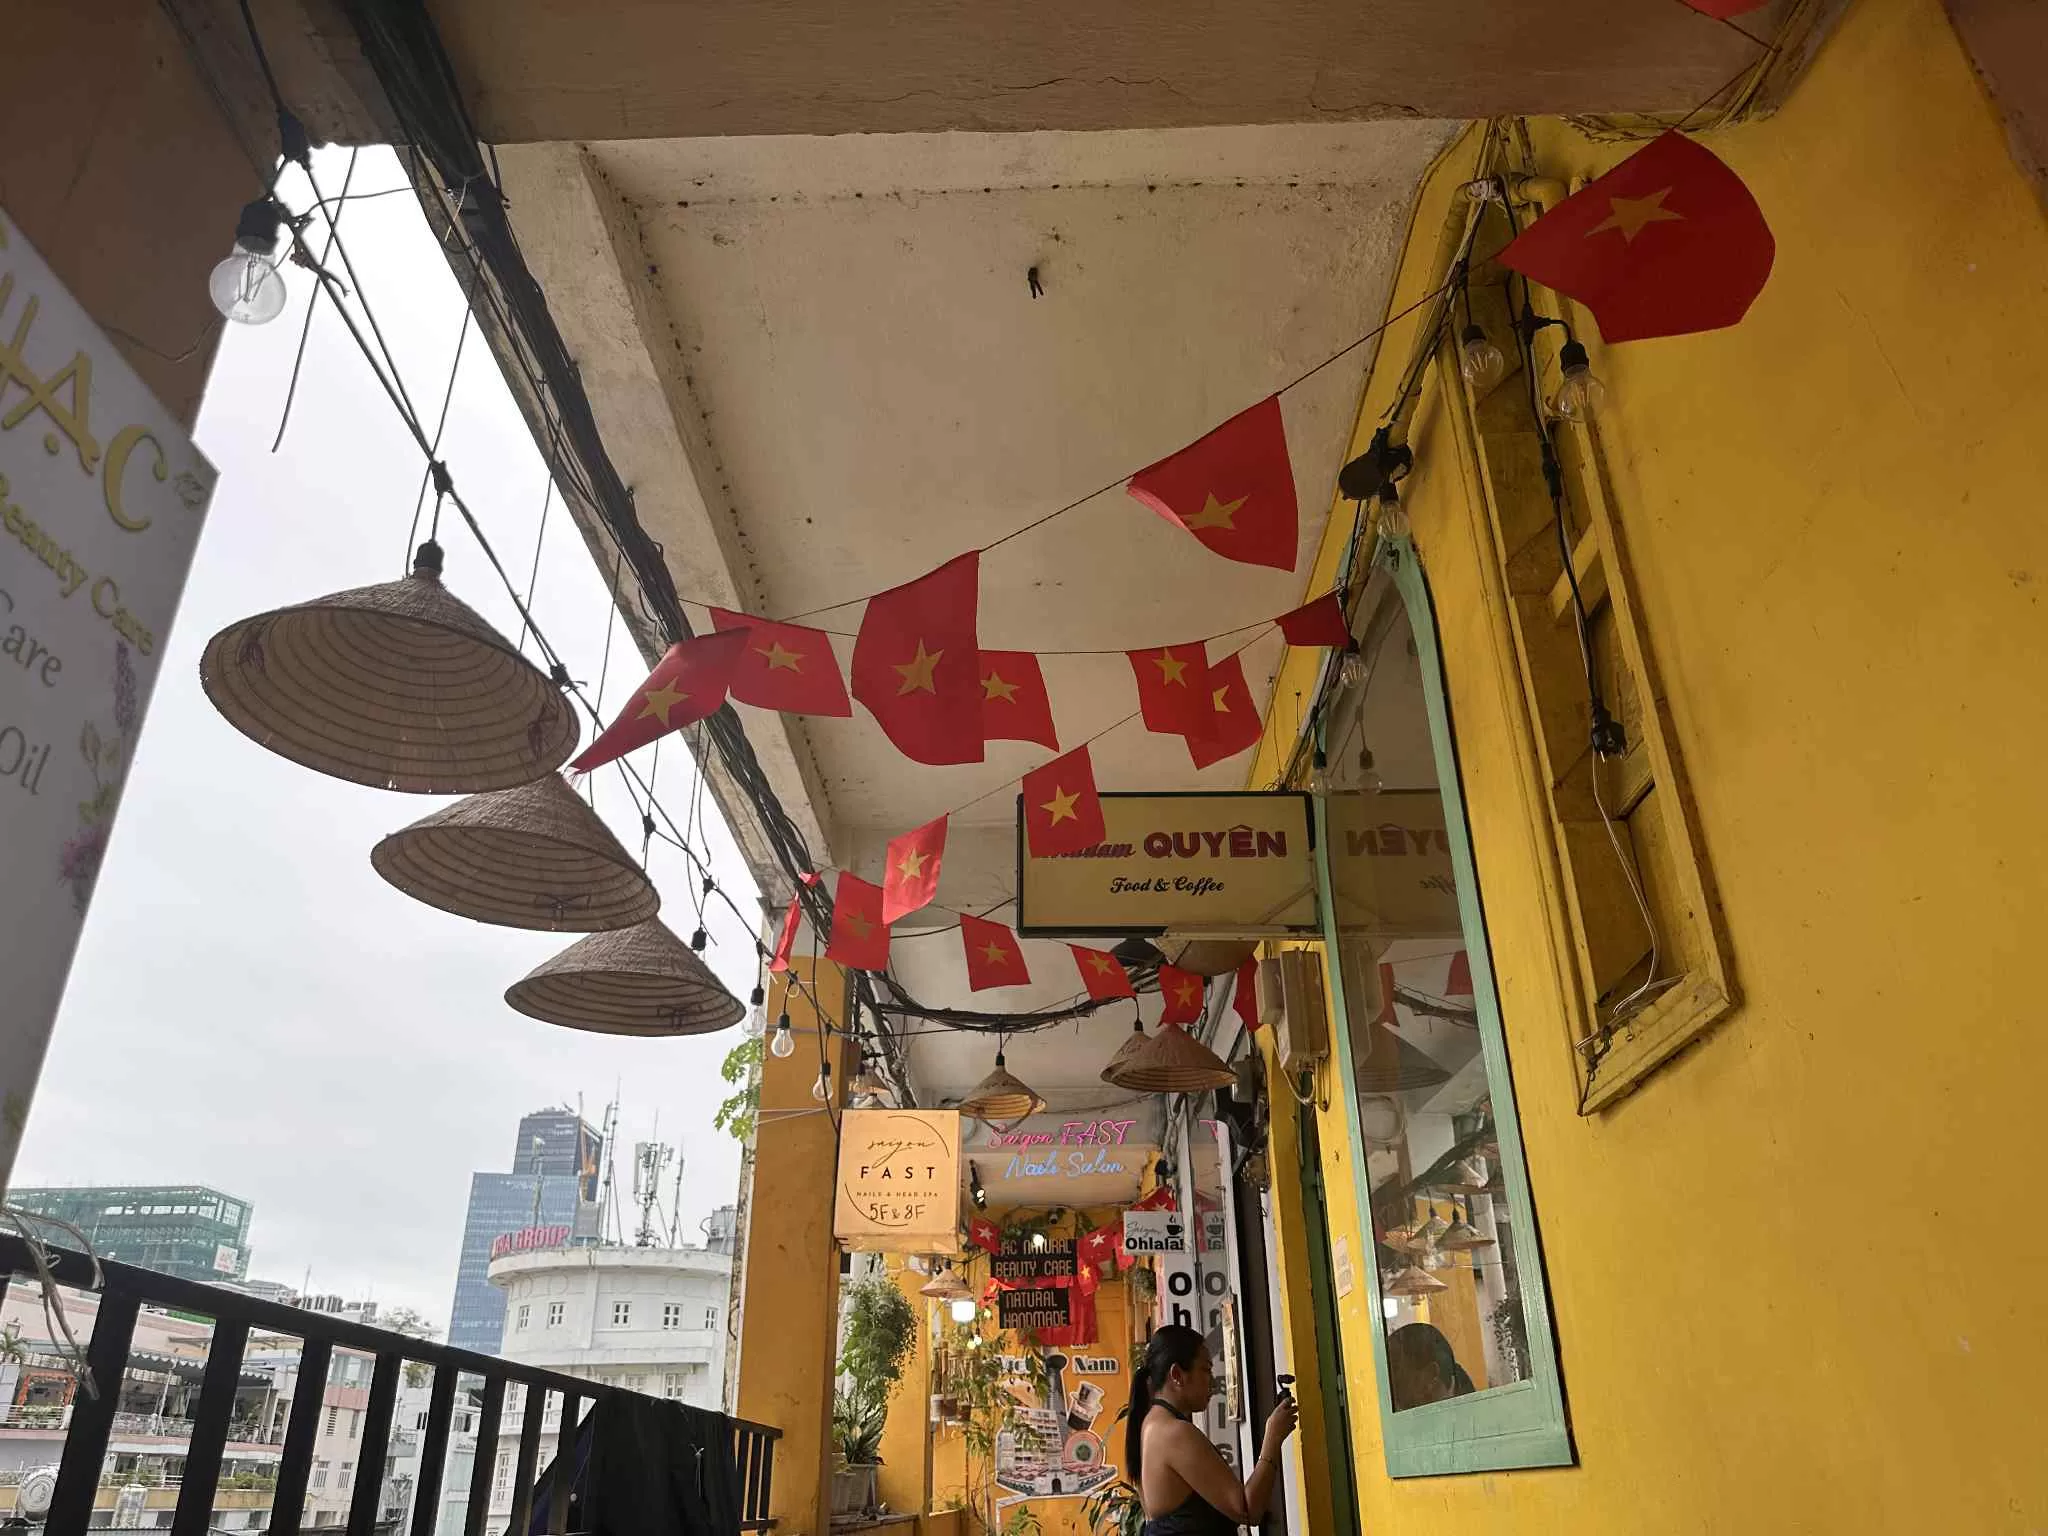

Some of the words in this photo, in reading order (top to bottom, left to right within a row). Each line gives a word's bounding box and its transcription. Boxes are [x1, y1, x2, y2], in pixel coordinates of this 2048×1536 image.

[91, 575, 153, 656] Care
[1143, 824, 1288, 858] QUYÊN
[1110, 876, 1151, 893] Food
[1154, 877, 1168, 892] &
[1173, 876, 1225, 896] Coffee
[1061, 1120, 1136, 1145] FAST
[860, 1165, 936, 1180] FAST
[995, 1261, 1037, 1278] BEAUTY
[1044, 1259, 1073, 1276] CARE
[1006, 1290, 1058, 1308] NATURAL
[1004, 1309, 1068, 1329] HANDMADE
[1074, 1356, 1117, 1371] Nam
